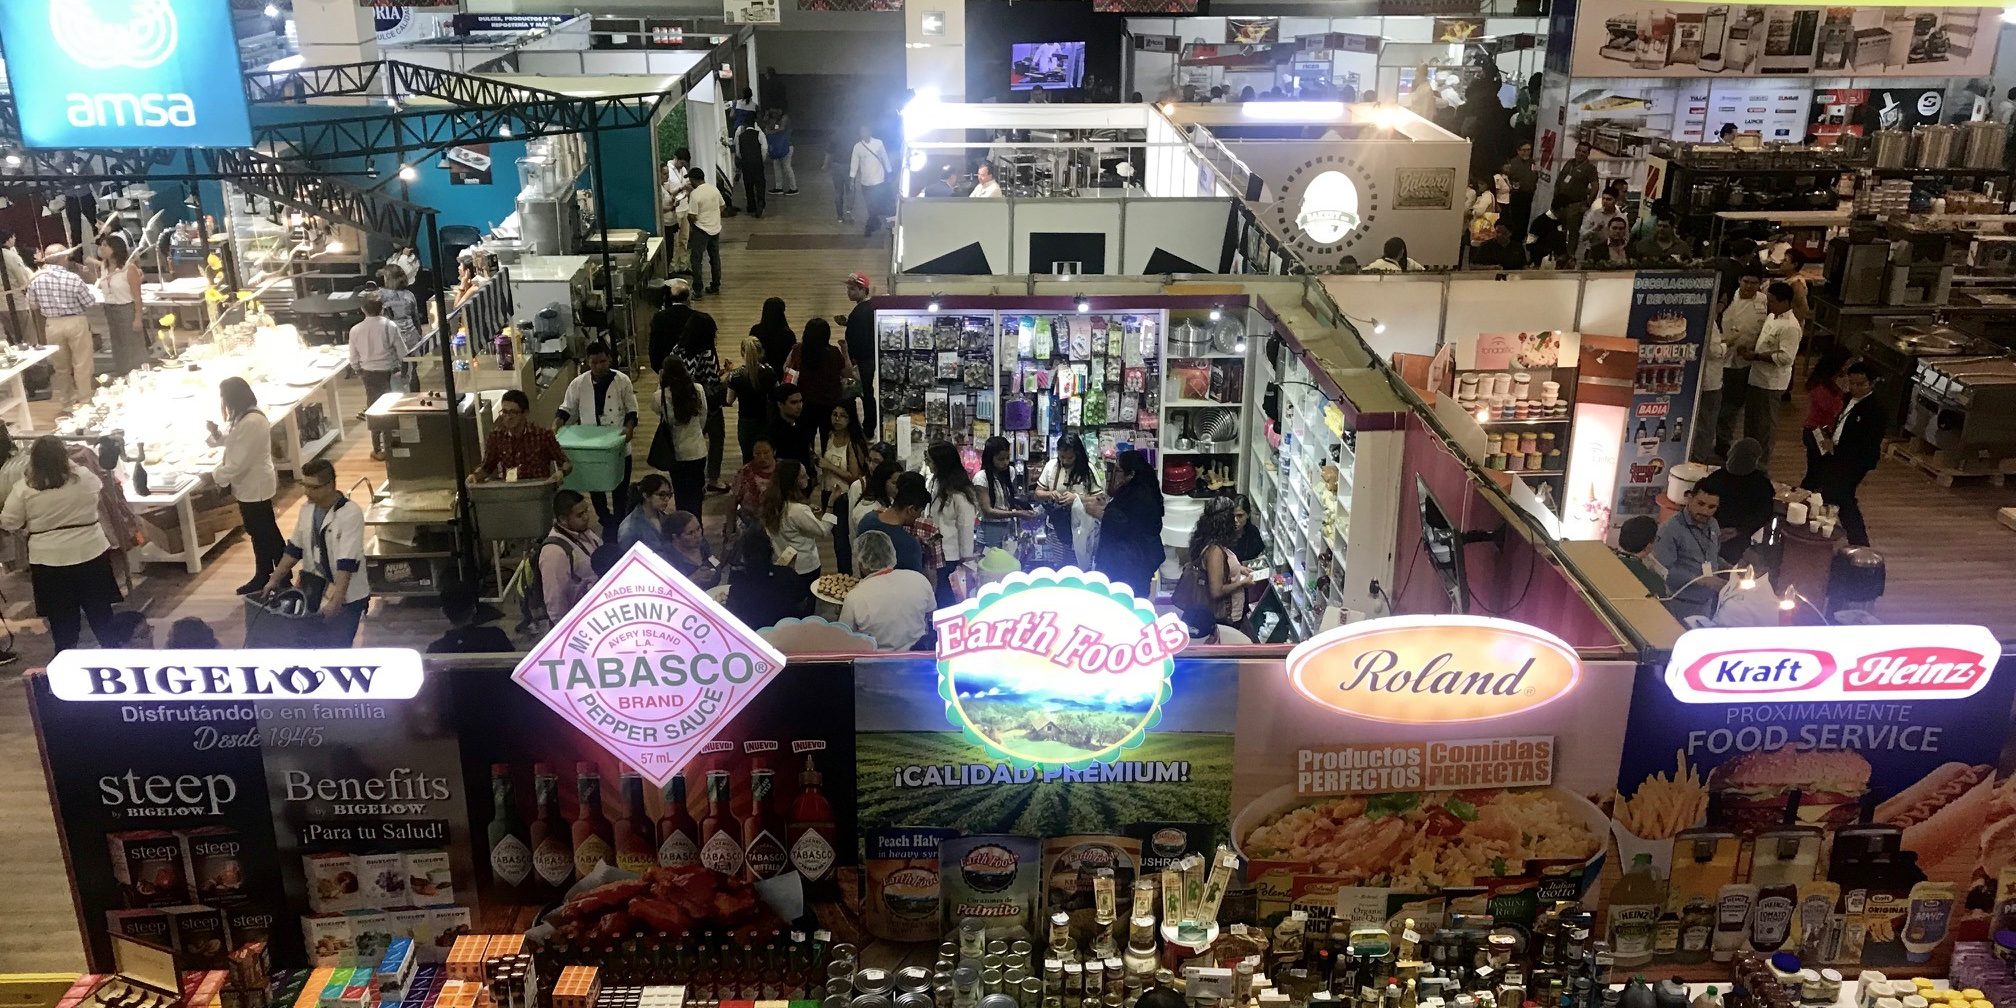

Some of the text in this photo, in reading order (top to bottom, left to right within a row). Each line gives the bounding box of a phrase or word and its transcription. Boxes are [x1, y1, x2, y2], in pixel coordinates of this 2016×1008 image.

[66, 92, 197, 128] amsa
[1634, 277, 1714, 290] DECORACIONES
[1636, 293, 1707, 305] Y REPOSTERIA
[1638, 404, 1669, 415] BADIA
[604, 586, 627, 600] MADE
[634, 585, 646, 593] IN
[682, 613, 711, 644] CO.
[608, 629, 681, 649] AVERY ISLAND
[635, 639, 654, 648] L.A.
[936, 612, 1190, 674] Earth Foods
[538, 652, 754, 692] TABASCO
[1340, 649, 1536, 696] Roland
[1716, 658, 1802, 683] Kraft
[1849, 655, 1976, 687] Heinz
[81, 665, 382, 695] BIGELOW
[619, 695, 684, 710] BRAND
[122, 703, 386, 723] Disfrutándolo en familia
[577, 687, 723, 743] PEPPER SAUCE
[1726, 703, 1913, 725] PROXIMAMENTE
[193, 726, 325, 750] Desde 1945
[1688, 724, 1942, 755] FOOD SERVICE
[640, 752, 674, 765] 57 mL
[1299, 747, 1421, 771] Productos
[1429, 740, 1550, 764] Comidas
[894, 761, 1189, 788] ¡CALIDAD PREMIUM!
[1299, 767, 1421, 793] PERFECTOS
[1429, 759, 1549, 786] PERFECTAS
[99, 768, 237, 816] steep
[281, 767, 451, 801] Benefits
[127, 806, 205, 817] BIGELOW
[333, 803, 426, 815] BIGELOW
[302, 823, 443, 844] ¡Para tu Salud!
[878, 834, 943, 847] Peach Halv
[131, 844, 177, 861] steep
[195, 841, 240, 856] steep
[659, 852, 698, 862] TABASCO
[702, 852, 742, 862] TABASCO
[748, 852, 785, 862] TABASCO
[792, 850, 833, 860] TABASCO
[878, 850, 886, 858] in
[889, 850, 918, 859] heavy
[960, 852, 988, 868] Earth
[956, 904, 1021, 916] Palmito
[1621, 910, 1649, 920] HEINZ
[127, 921, 166, 934] steep
[181, 916, 219, 930] steep
[233, 913, 273, 929] steep
